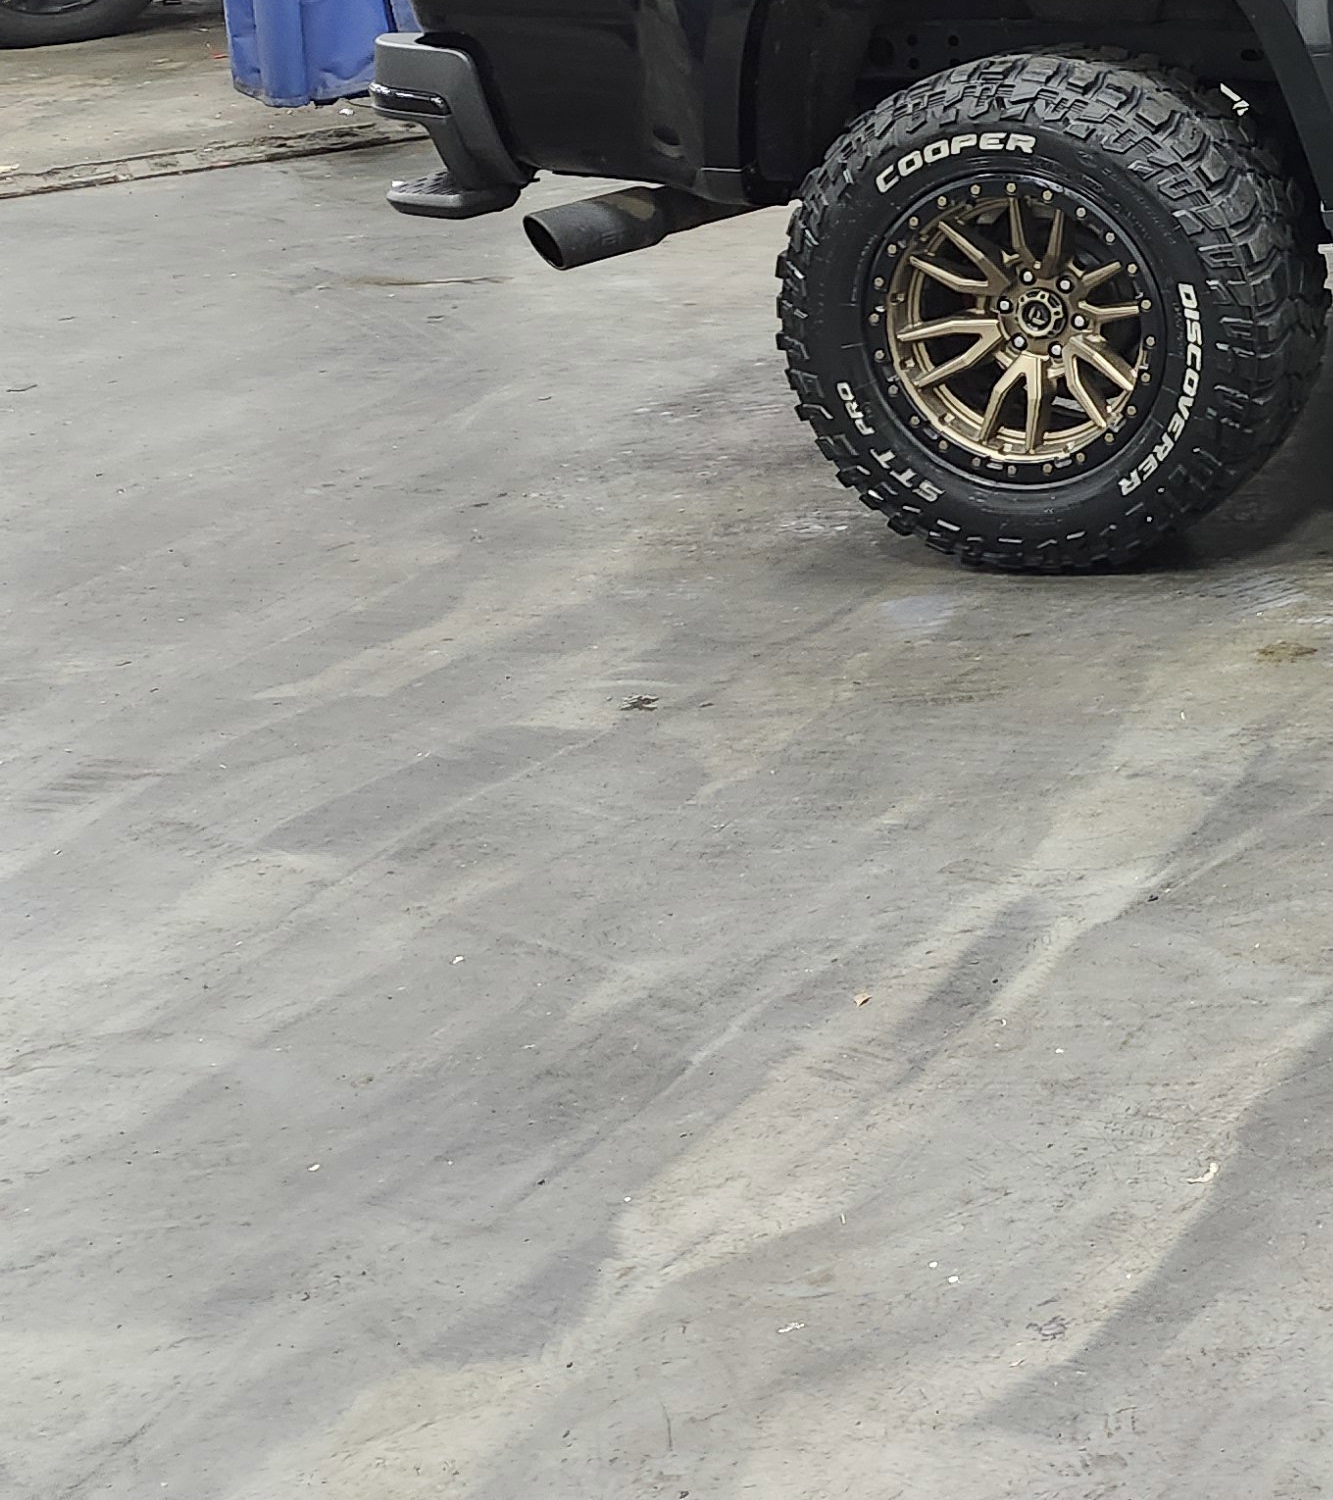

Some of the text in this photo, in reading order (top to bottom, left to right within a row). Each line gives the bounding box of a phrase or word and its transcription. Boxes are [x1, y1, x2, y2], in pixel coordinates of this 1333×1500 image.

[875, 131, 1036, 193] COOPER
[836, 381, 946, 502] STT PRO
[1117, 282, 1203, 496] DISCOVERER
